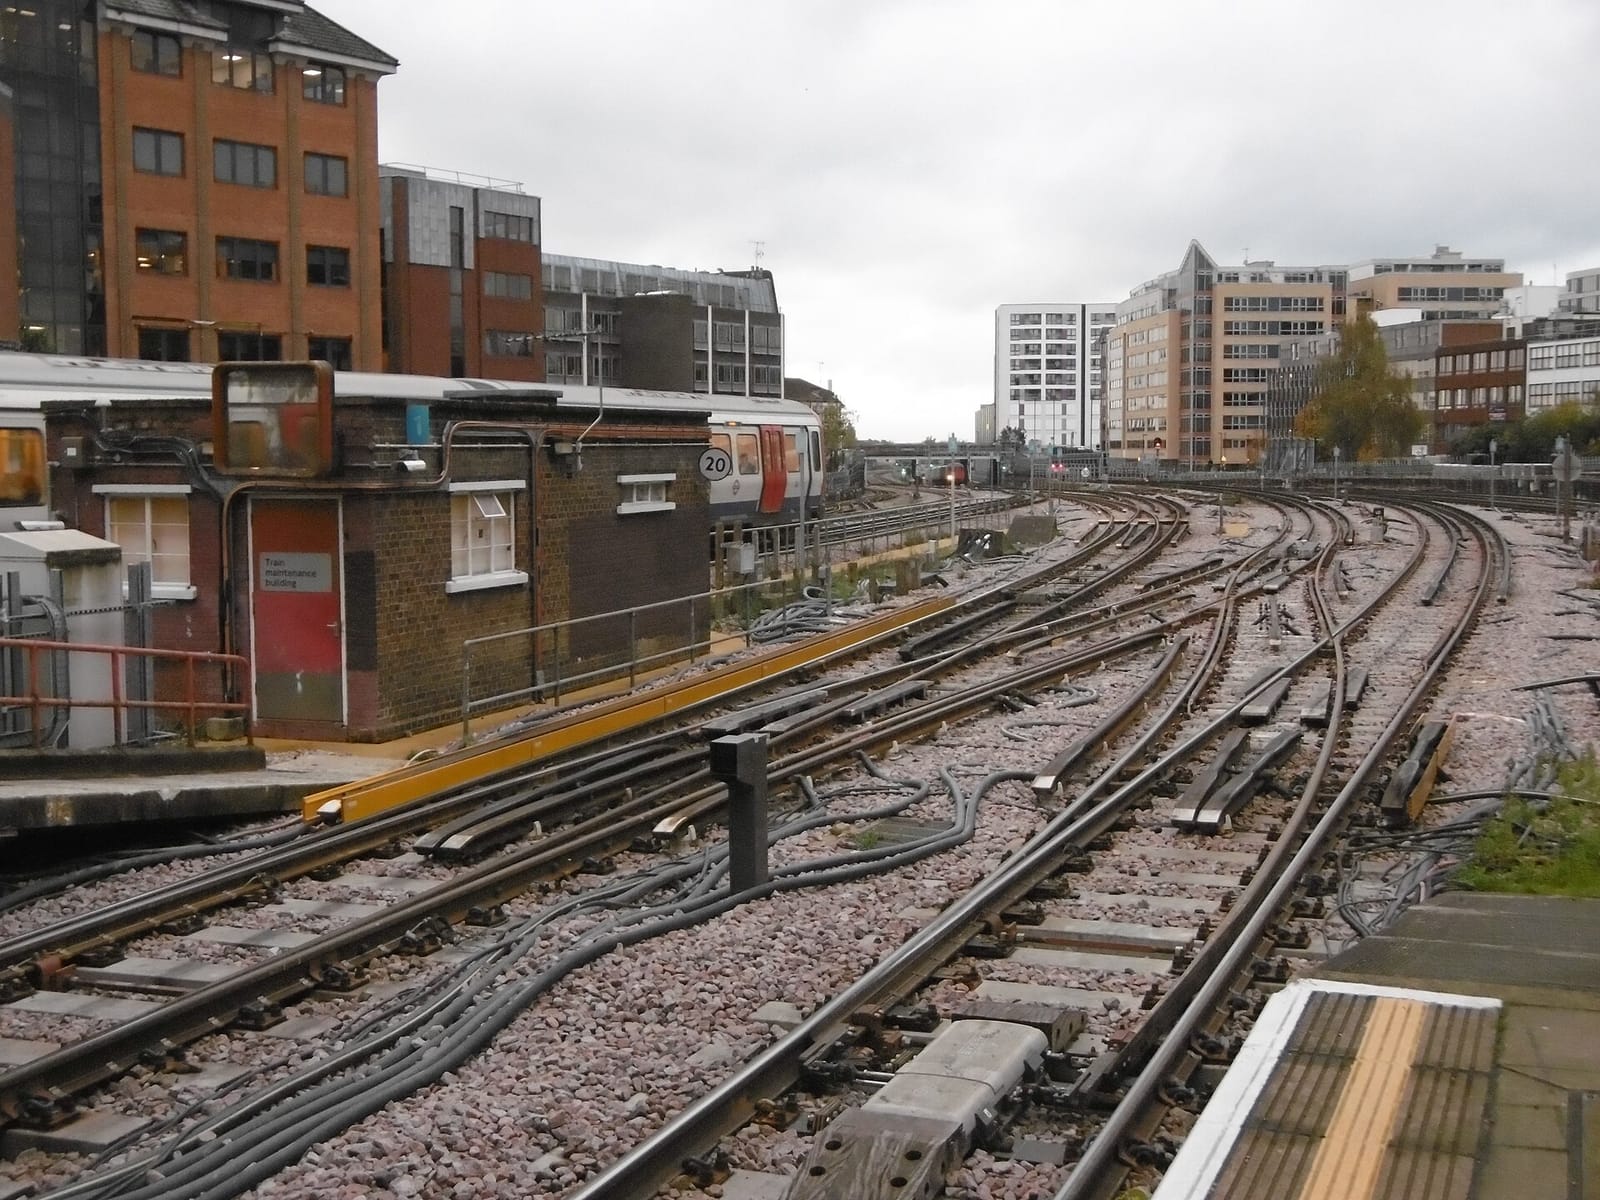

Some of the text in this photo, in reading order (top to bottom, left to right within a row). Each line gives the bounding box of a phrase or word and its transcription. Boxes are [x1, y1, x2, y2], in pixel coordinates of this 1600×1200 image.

[705, 456, 726, 473] 20
[265, 558, 286, 567] Train
[265, 569, 317, 578] maintenance
[265, 579, 297, 589] building
